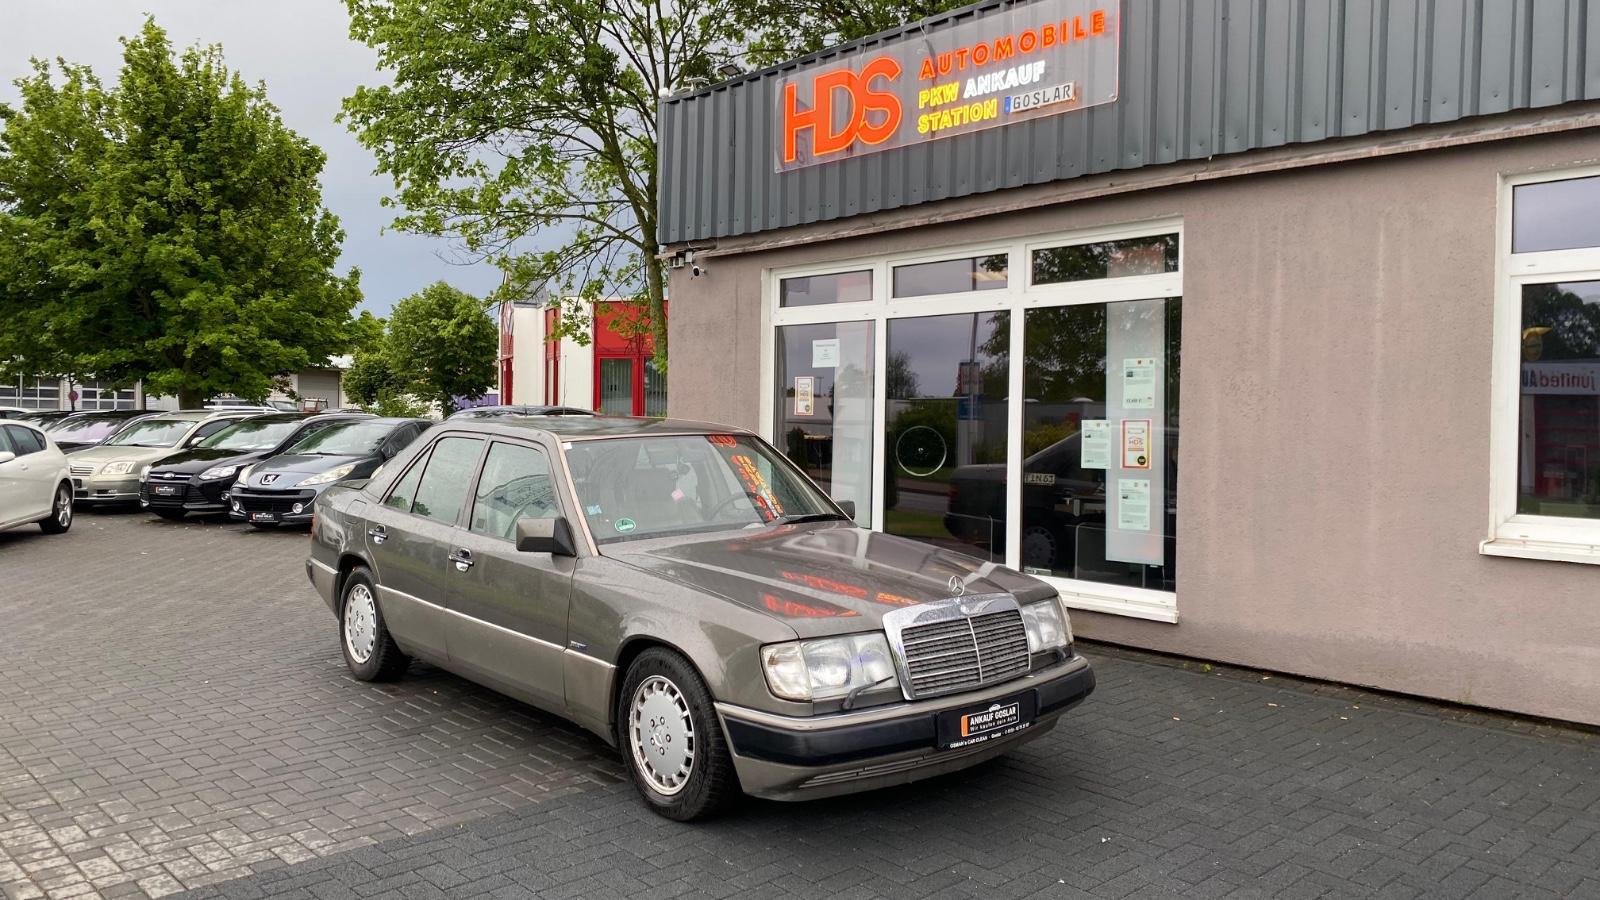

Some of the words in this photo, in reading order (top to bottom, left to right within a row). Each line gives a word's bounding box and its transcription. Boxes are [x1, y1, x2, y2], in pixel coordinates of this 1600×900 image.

[919, 10, 1106, 81] AUTOMOBILE
[784, 57, 902, 162] HDS
[917, 98, 998, 134] STATION
[1013, 84, 1071, 109] GOSLAR
[919, 82, 960, 109] PKW
[963, 60, 1046, 99] ANKAUF
[970, 713, 993, 725] ANKAUF
[995, 706, 1016, 719] GOSLAR
